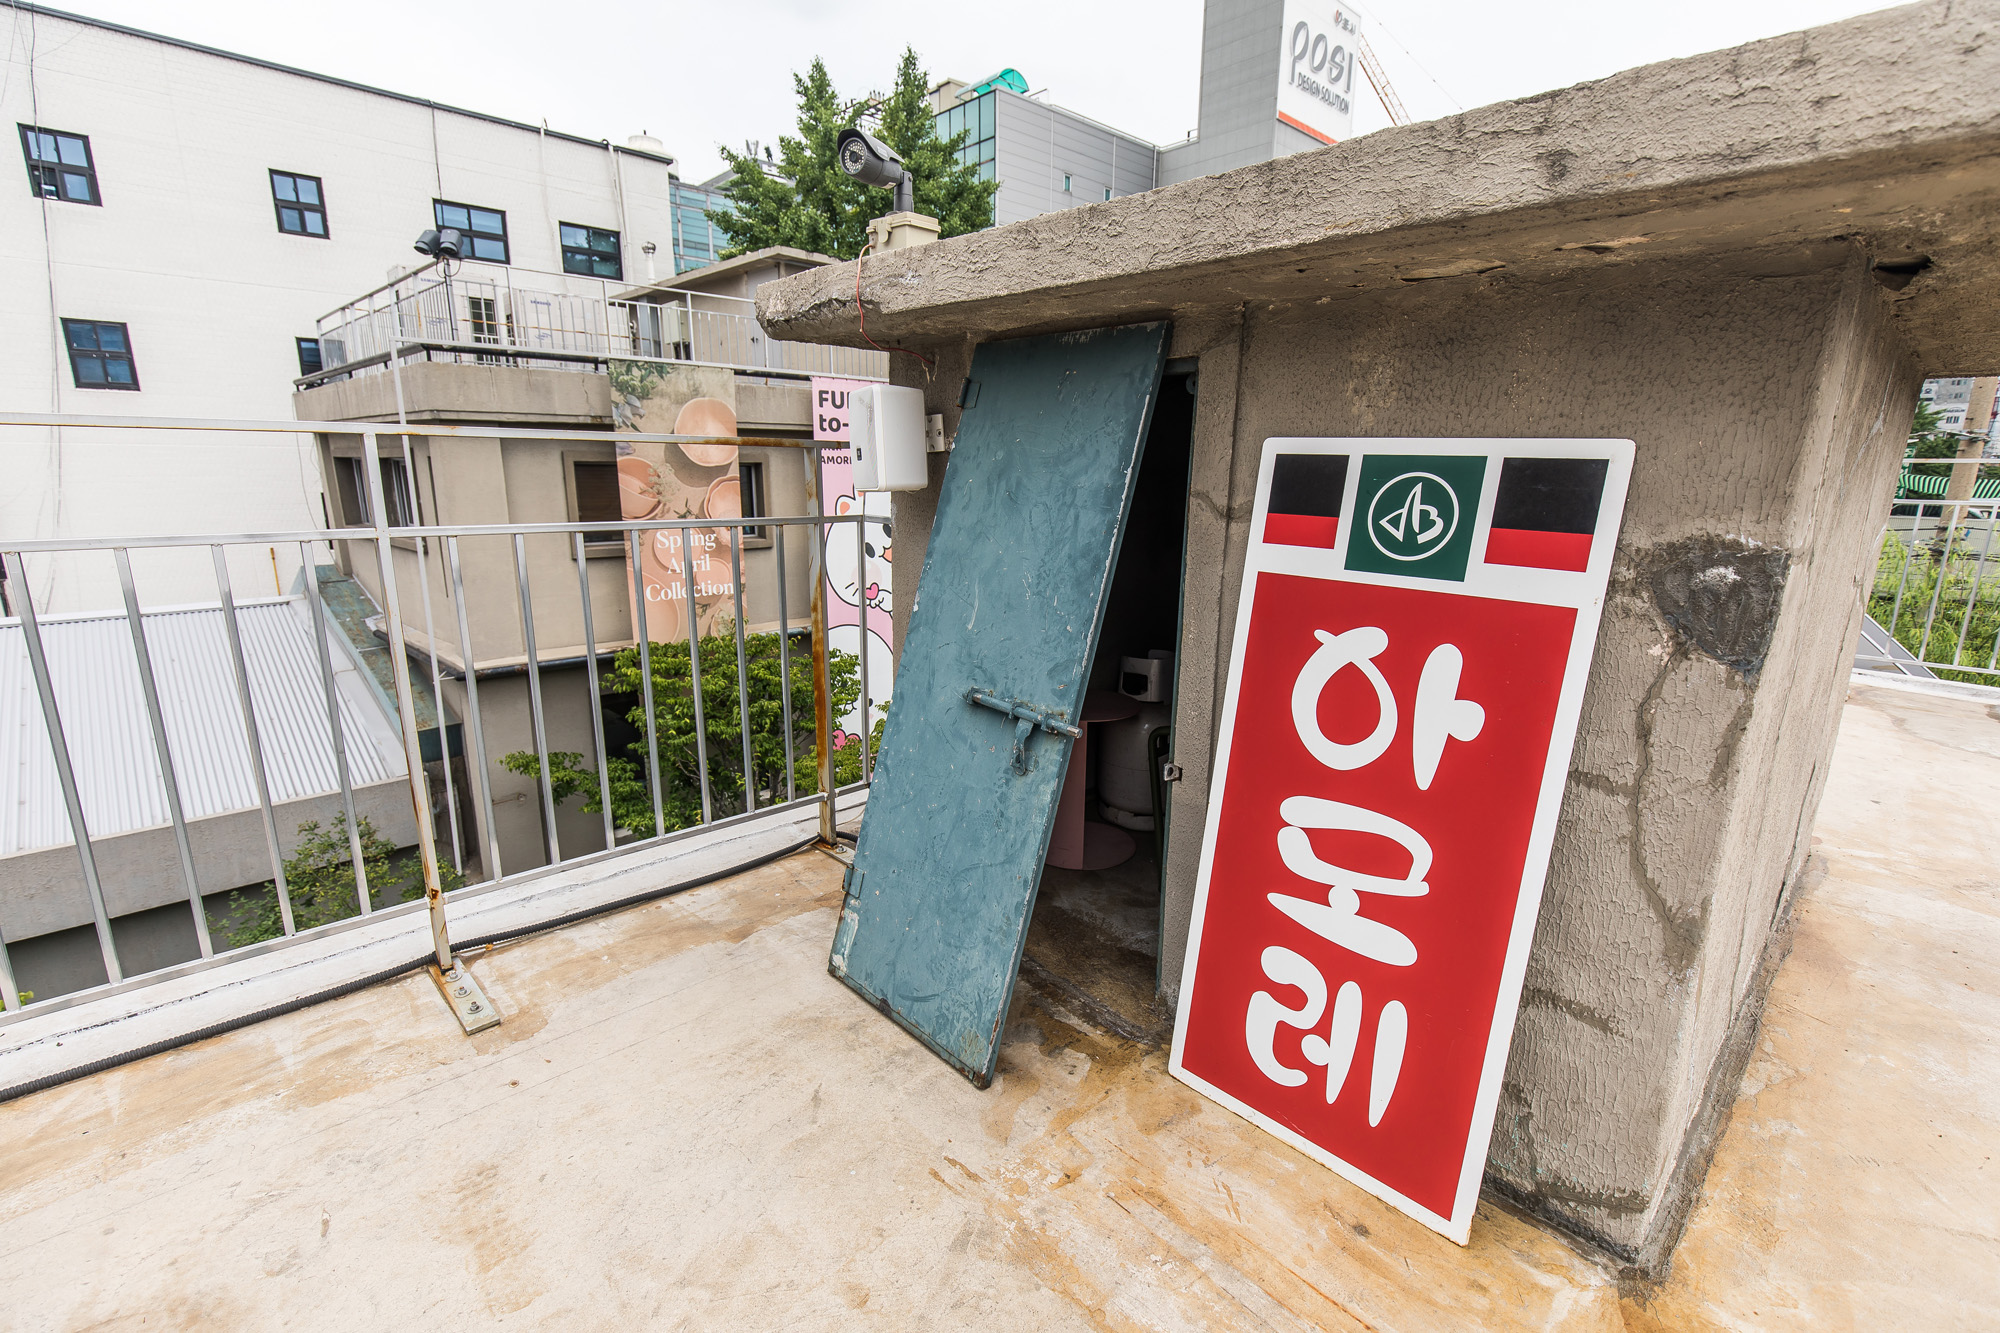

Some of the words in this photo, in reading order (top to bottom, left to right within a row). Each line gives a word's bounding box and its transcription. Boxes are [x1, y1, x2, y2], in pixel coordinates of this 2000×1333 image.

[1298, 72, 1321, 98] DESIGN
[1320, 86, 1350, 115] SOLUTION
[656, 531, 716, 554] Sping
[1246, 626, 1486, 1128] 아모레
